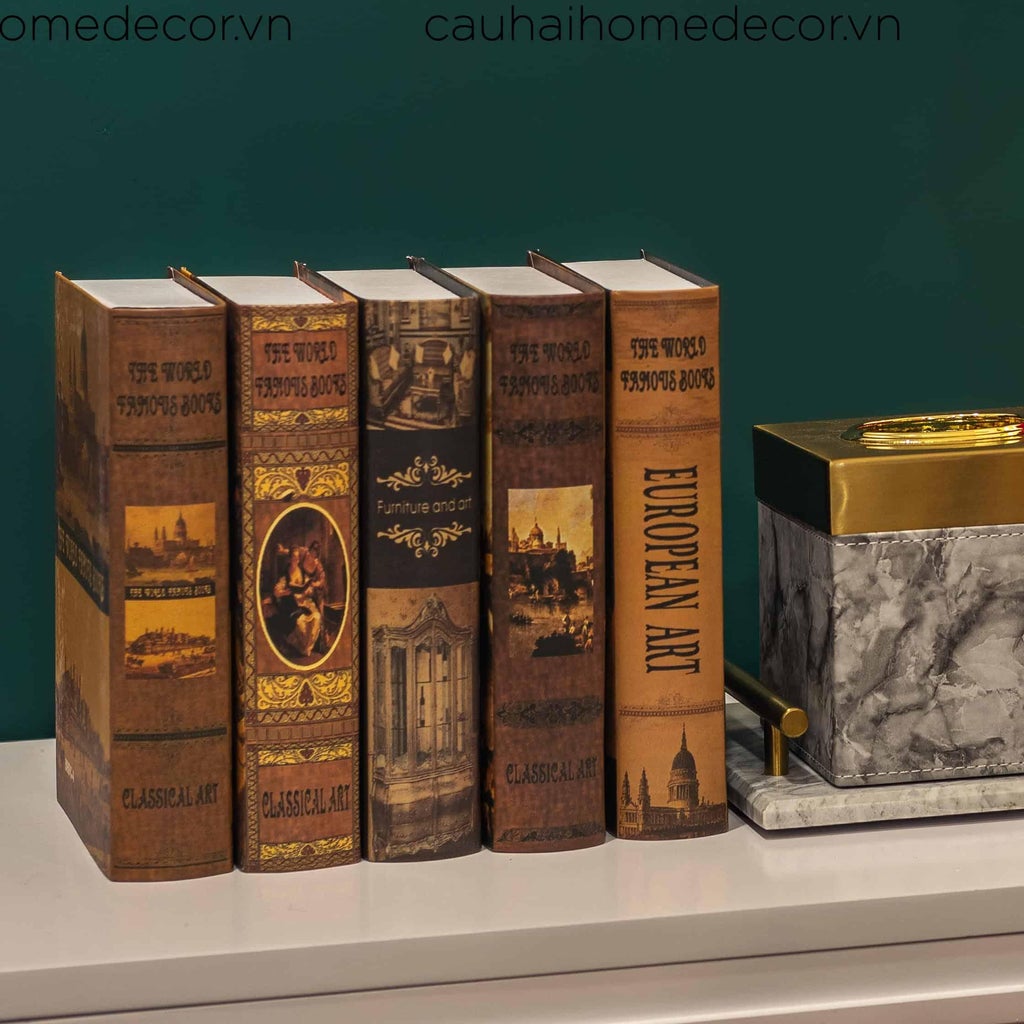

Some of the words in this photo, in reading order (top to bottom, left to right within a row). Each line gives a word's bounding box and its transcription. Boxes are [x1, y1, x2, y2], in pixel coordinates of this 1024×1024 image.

[264, 342, 291, 365] THE
[293, 340, 338, 364] WORLD
[510, 341, 539, 364] THE
[542, 339, 591, 363] WORLD
[630, 337, 659, 360] THE
[661, 335, 707, 360] WORLD
[128, 361, 158, 384] THE
[160, 360, 212, 384] WORLD
[255, 375, 308, 398] FAMOUS
[310, 372, 347, 398] BOOKS
[499, 373, 559, 397] FAMOUS
[560, 370, 600, 396] BOOKS
[620, 369, 677, 392] FAMOUS
[679, 366, 716, 392] BOOKS
[116, 394, 178, 417] FAMOUS
[180, 391, 222, 417] BOOKS
[377, 499, 430, 515] Furniture
[432, 497, 456, 513] and
[458, 496, 473, 511] art
[643, 464, 700, 611] EUROPEAN
[644, 623, 701, 676] ART
[506, 759, 575, 785] CLASSICAL
[577, 756, 598, 780] ART
[122, 785, 193, 810] CLASSICAL
[195, 782, 219, 806] ART
[262, 788, 326, 818] CLASSICAL
[328, 783, 351, 813] ART
